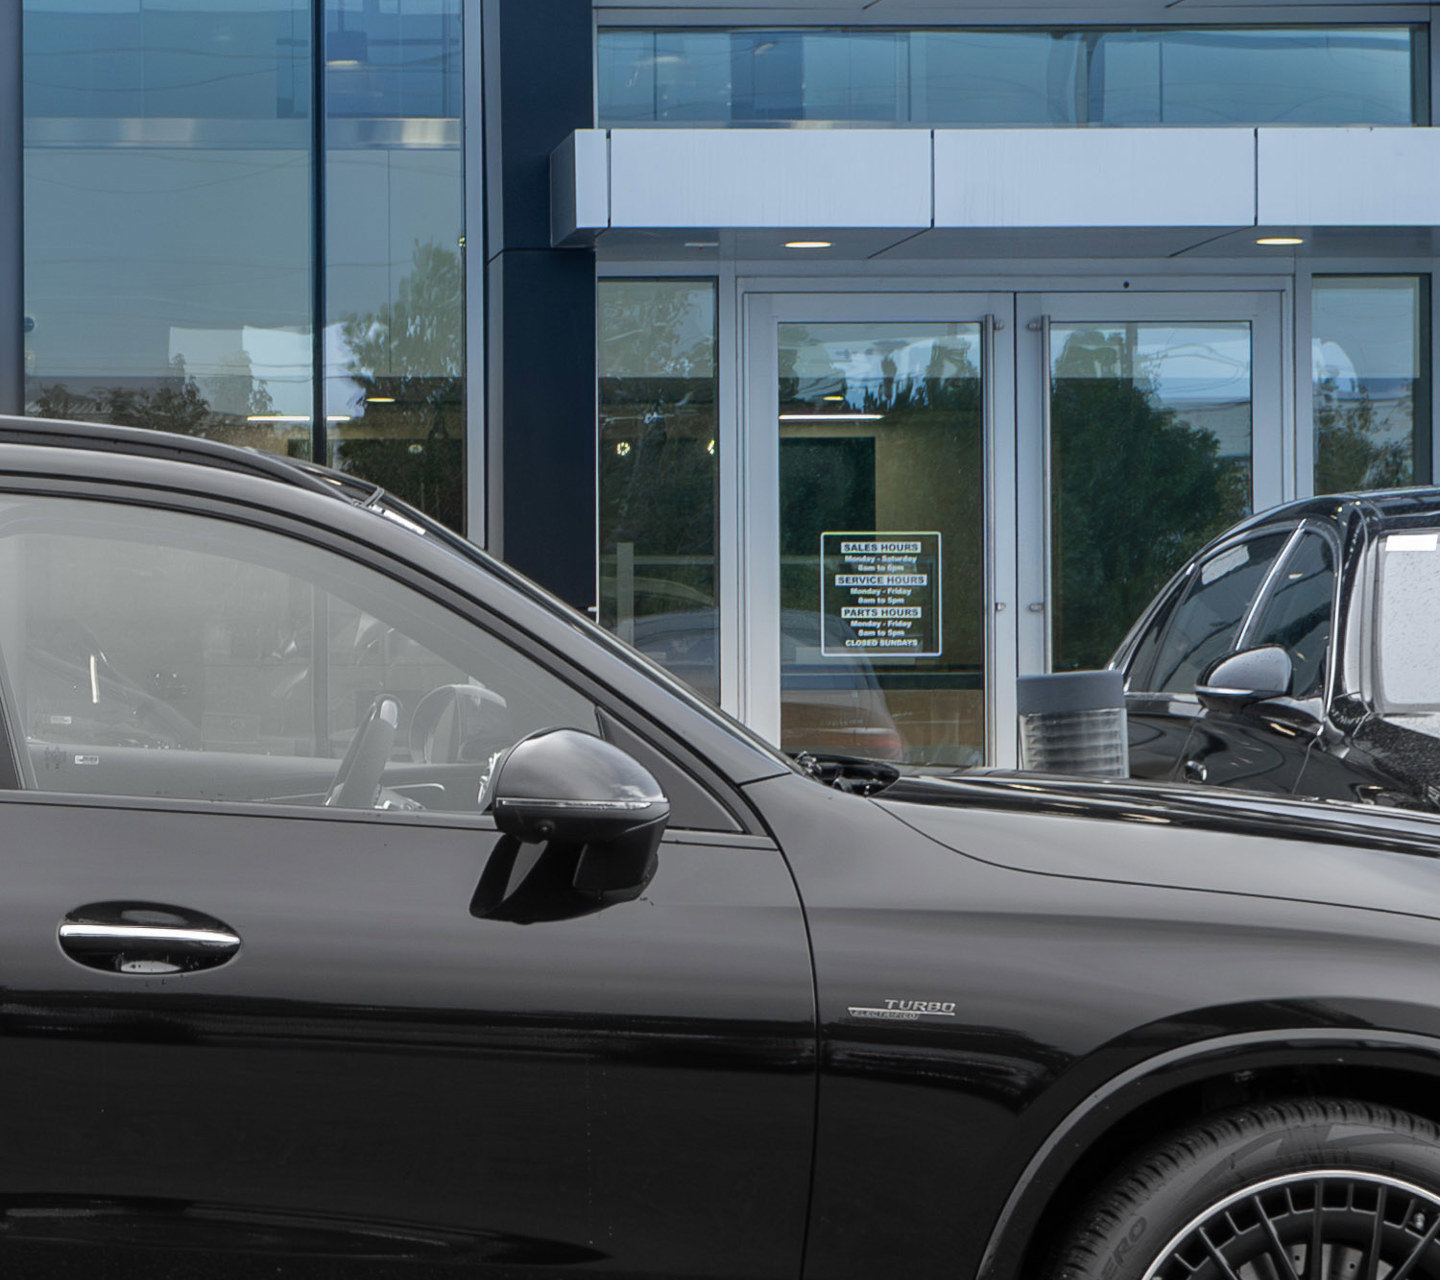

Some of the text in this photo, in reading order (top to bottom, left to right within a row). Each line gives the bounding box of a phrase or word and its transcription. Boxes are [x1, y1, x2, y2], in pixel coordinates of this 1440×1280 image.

[844, 543, 918, 552] SALES HOURS
[844, 555, 875, 564] Monday
[882, 555, 918, 564] Saturday
[838, 576, 924, 584] SERVICE HOURS
[850, 587, 881, 596] Monday
[887, 587, 912, 596] Friday
[844, 608, 919, 617] PARTS HOURS
[850, 620, 881, 628] Monday
[887, 620, 912, 629] Friday
[845, 639, 918, 647] CLOSED SUNDAYS
[884, 999, 956, 1012] TURBO
